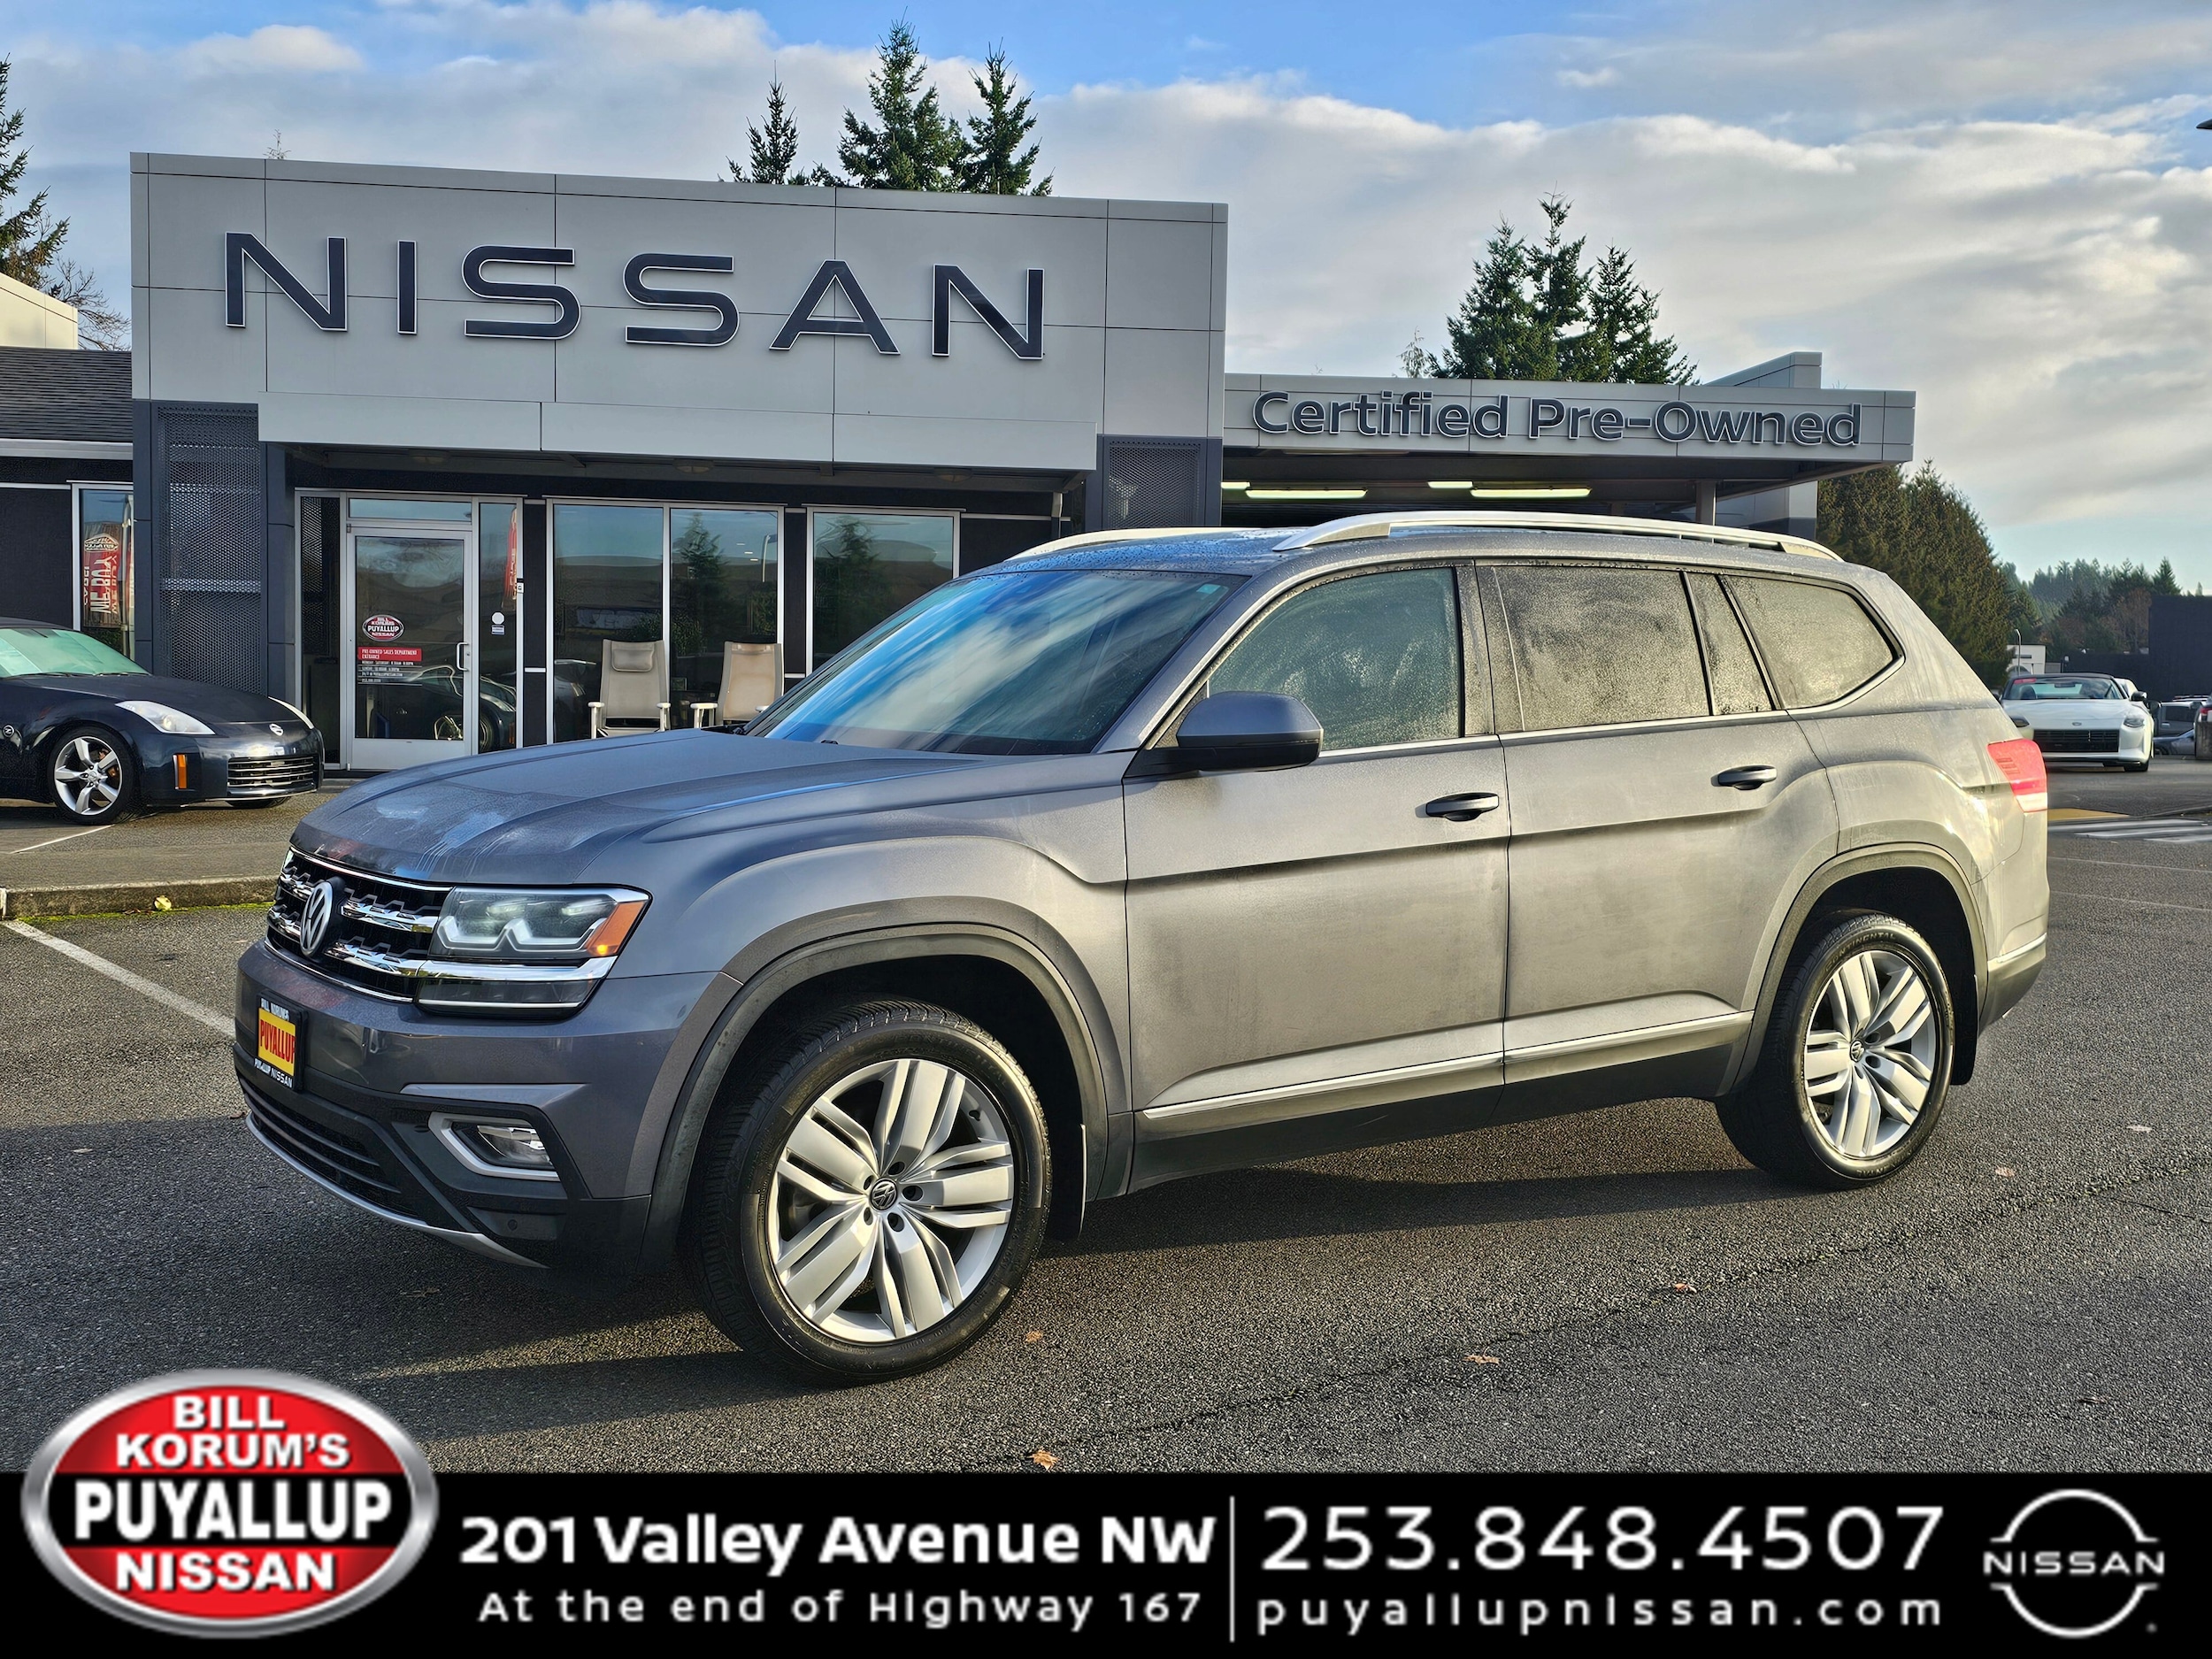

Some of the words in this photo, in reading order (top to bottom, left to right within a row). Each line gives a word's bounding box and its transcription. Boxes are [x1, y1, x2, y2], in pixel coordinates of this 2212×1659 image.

[224, 231, 1045, 361] NISSAN
[1252, 390, 1509, 438] Certified
[1528, 399, 1862, 446] Pre-Owned
[270, 1067, 294, 1089] NISSAN
